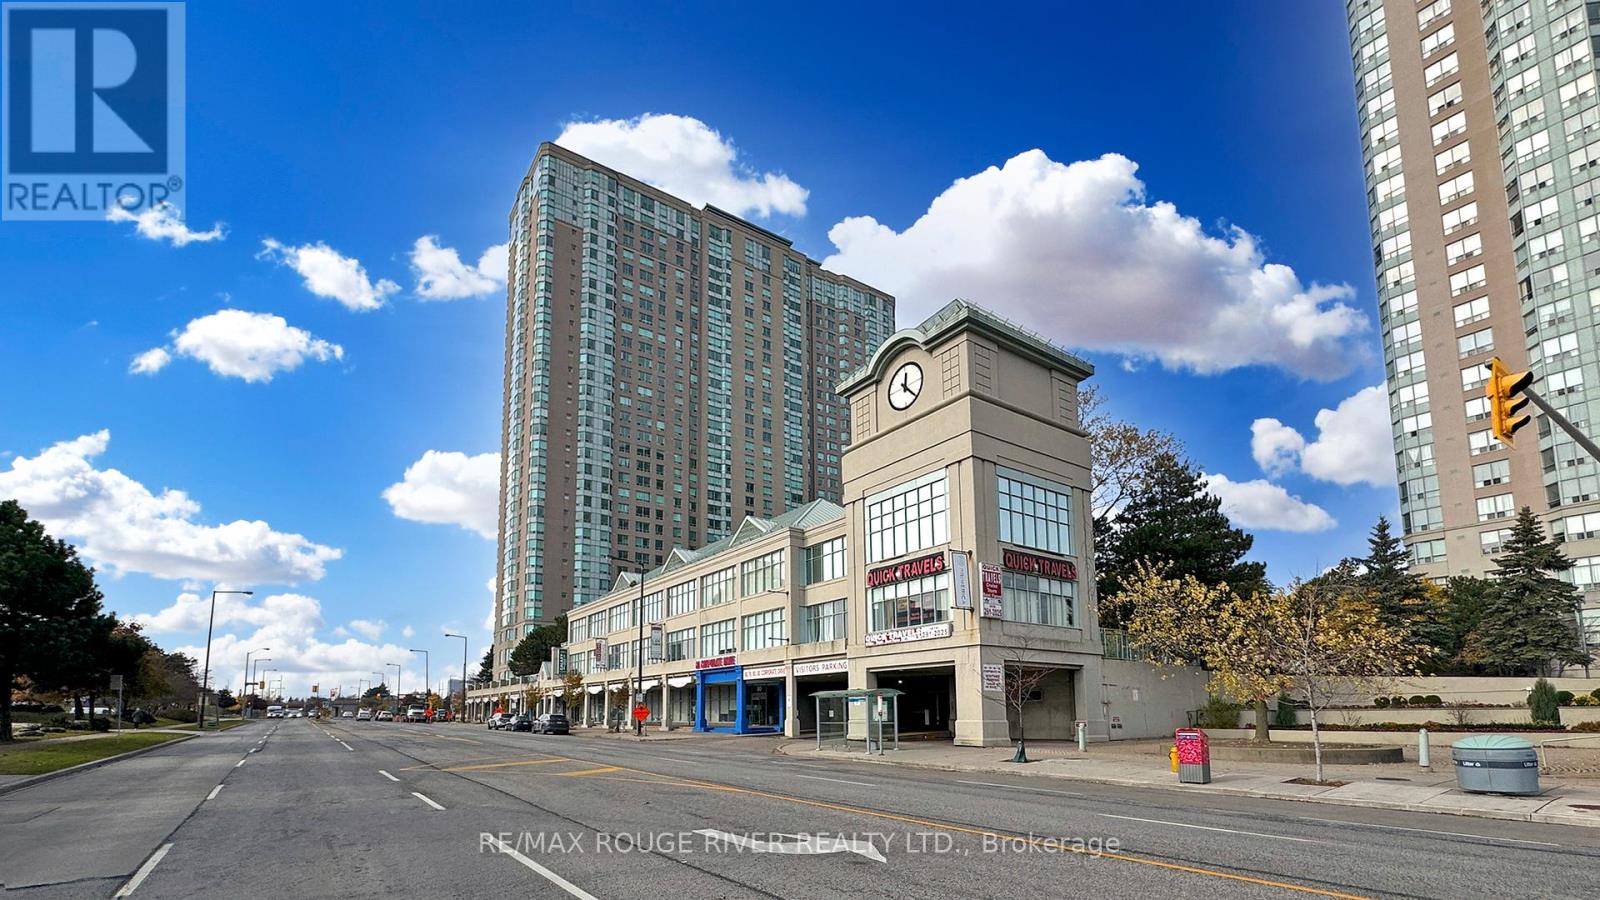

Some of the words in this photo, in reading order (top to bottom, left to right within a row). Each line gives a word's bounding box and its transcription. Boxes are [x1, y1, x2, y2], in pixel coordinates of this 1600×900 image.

[866, 567, 895, 587] QUICK
[897, 555, 944, 580] TRAVELS
[1005, 552, 1037, 572] QUICK
[1039, 559, 1078, 579] TRAVELS
[794, 664, 820, 674] VISITORS
[822, 660, 848, 671] PARKING
